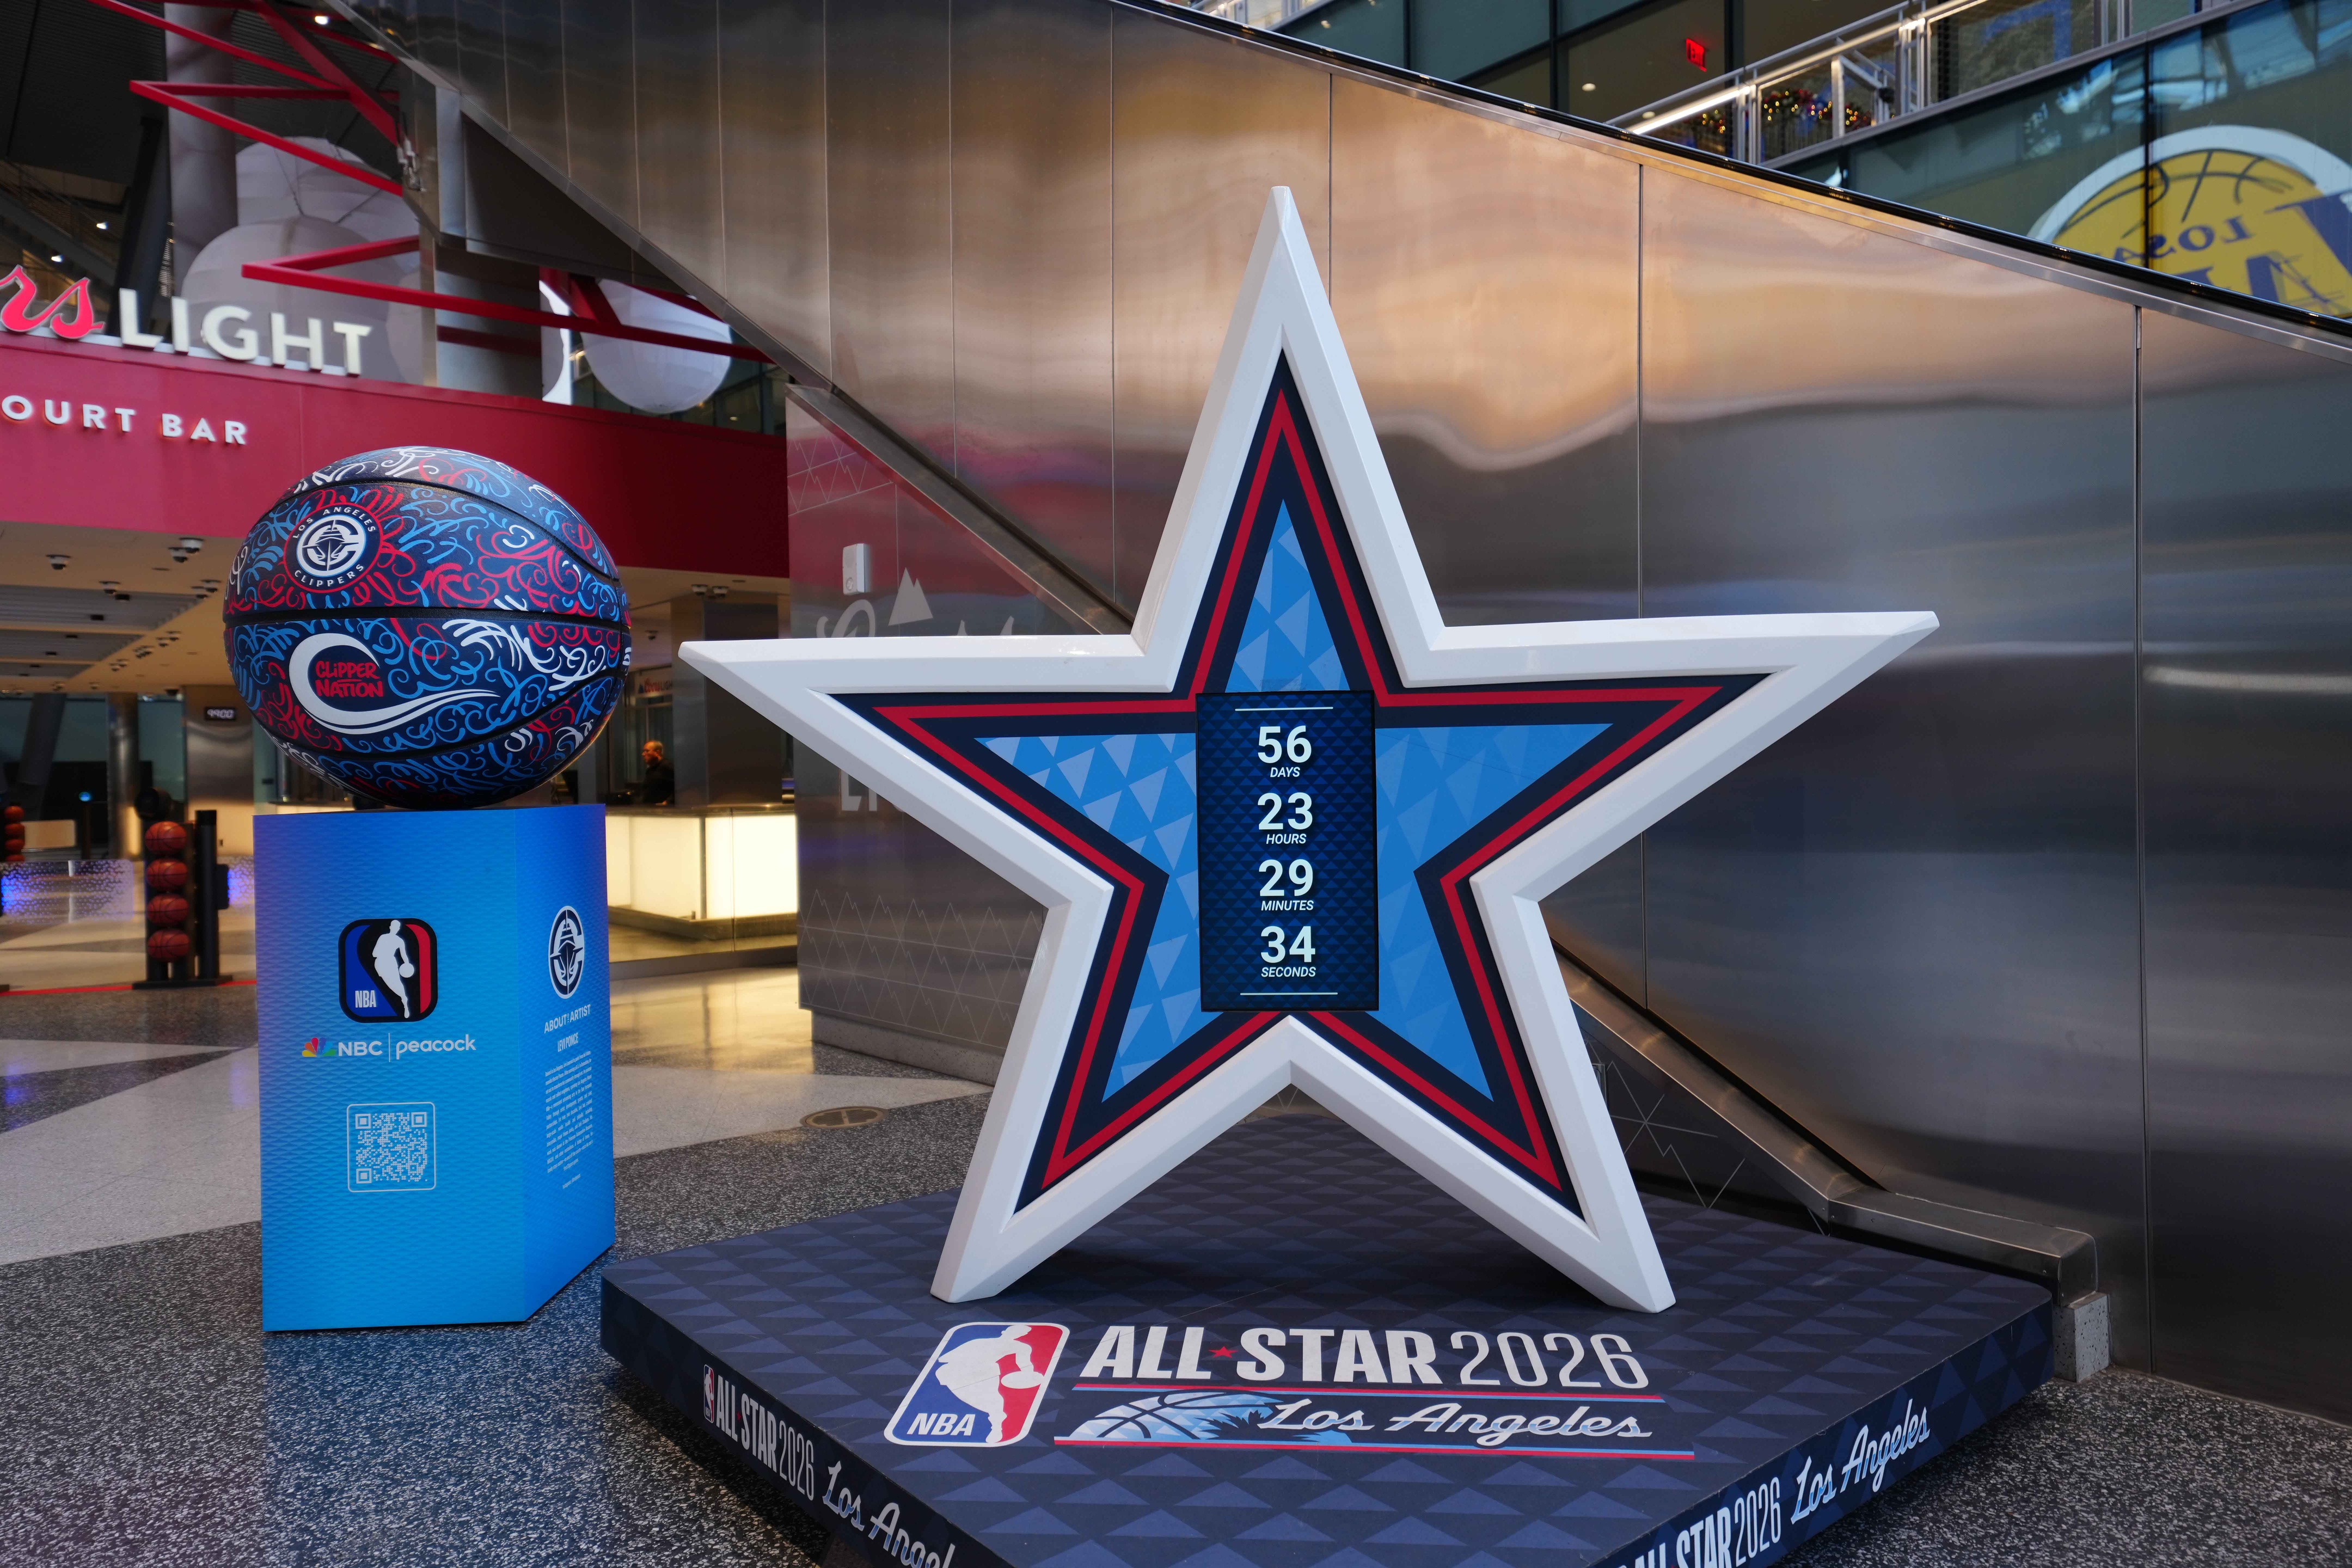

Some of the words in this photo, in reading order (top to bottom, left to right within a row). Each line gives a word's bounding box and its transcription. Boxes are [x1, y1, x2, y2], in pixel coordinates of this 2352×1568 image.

[119, 287, 372, 375] LIGHT
[2, 395, 136, 432] OURT
[162, 413, 247, 445] BAR
[292, 518, 314, 539] LOS
[323, 506, 376, 532] ANGELES
[295, 564, 364, 587] CLIPPERS
[315, 679, 384, 697] NATION
[1258, 725, 1312, 763] 56
[1270, 767, 1300, 777] DAYS
[1258, 793, 1313, 830] 23
[1266, 834, 1306, 844] HOURS
[1259, 859, 1313, 897] 29
[1261, 900, 1314, 911] MINUTES
[1260, 926, 1315, 963] 34
[1261, 966, 1316, 977] SECONDS
[355, 990, 376, 1008] NBA
[544, 1014, 567, 1033] ABOUT
[570, 1004, 591, 1022] ARTIST
[338, 1040, 382, 1056] NBC
[396, 1034, 476, 1059] peacock
[558, 1038, 566, 1052] LEVI
[566, 1032, 578, 1048] PONCE
[1079, 1326, 1212, 1379] ALL
[1236, 1327, 1443, 1384] STAR
[1450, 1331, 1649, 1389] 2026
[716, 1375, 738, 1442] ALL
[741, 1393, 777, 1473] STAR
[779, 1420, 814, 1502] 2026
[907, 1413, 976, 1436] NBA
[1257, 1399, 1374, 1431] Los
[1379, 1402, 1652, 1446] Angeles
[1791, 1456, 1837, 1525] Los
[1840, 1399, 1931, 1492] Angeles
[822, 1460, 865, 1532] Los
[1676, 1507, 1731, 1568] STAR
[1735, 1477, 1781, 1564] 2026
